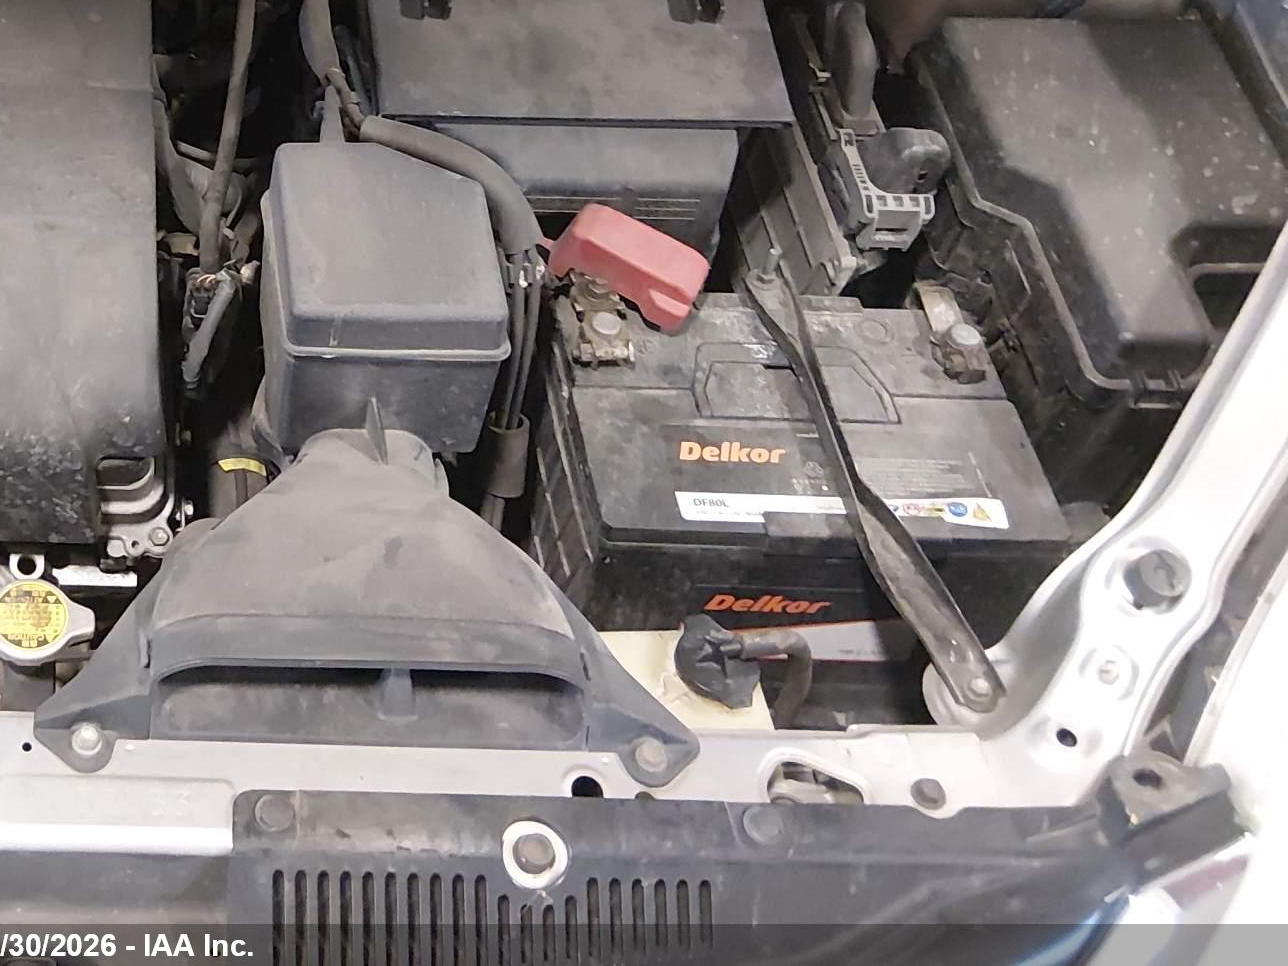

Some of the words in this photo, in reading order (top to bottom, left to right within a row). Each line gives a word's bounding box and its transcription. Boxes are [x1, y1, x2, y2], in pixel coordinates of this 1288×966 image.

[679, 441, 786, 463] Delkor
[693, 498, 729, 508] DF80L
[704, 594, 831, 613] Delkor
